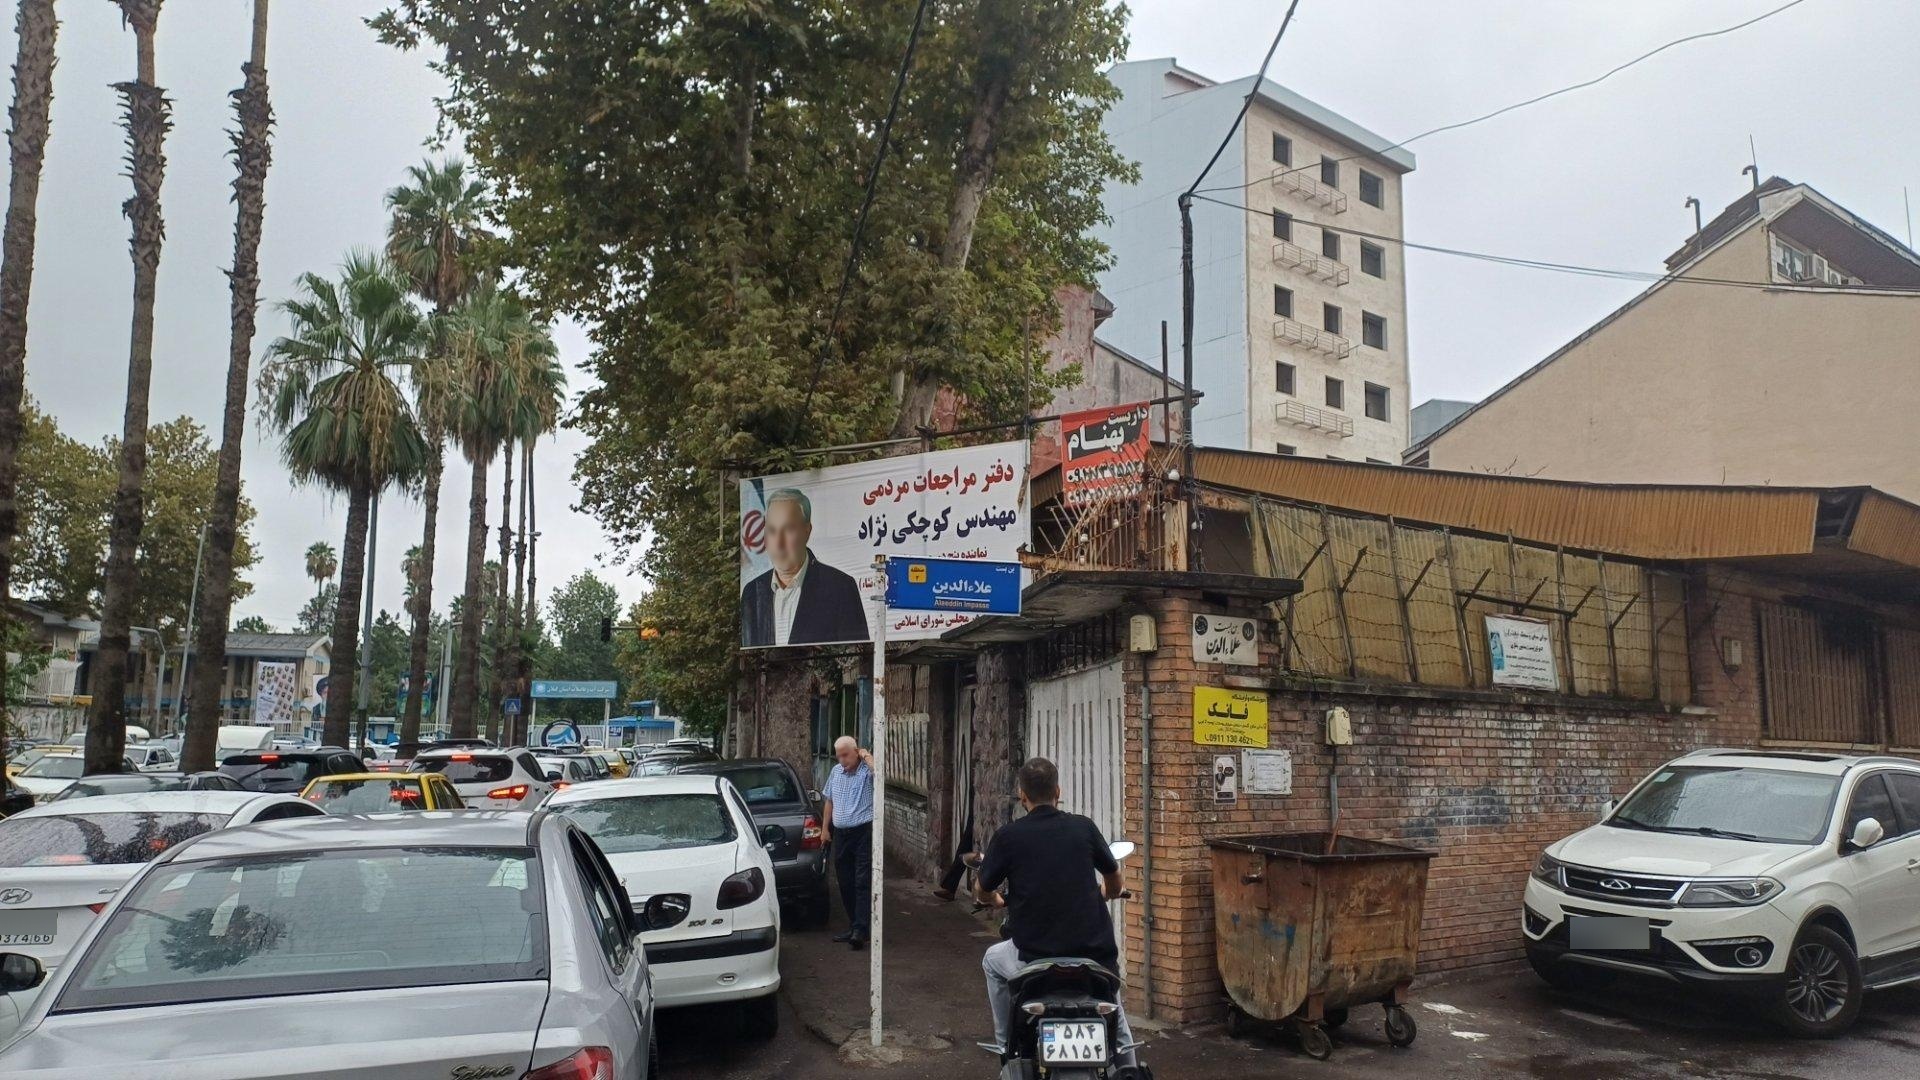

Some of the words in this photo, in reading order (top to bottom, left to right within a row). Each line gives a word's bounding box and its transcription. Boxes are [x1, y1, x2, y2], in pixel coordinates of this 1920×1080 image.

[1107, 404, 1148, 426] داربست
[1068, 424, 1125, 461] بهنام
[913, 465, 977, 495] مراجعات
[981, 459, 1014, 492] دفتر
[863, 479, 909, 505] مردمی
[858, 513, 887, 546] نژاد
[892, 506, 951, 543] کوچکی
[956, 505, 1016, 537] مهندس
[960, 547, 988, 558] نماینده
[932, 579, 992, 595] علاءالدین
[894, 614, 919, 630] اسلامی
[920, 614, 944, 629] شورای
[945, 613, 969, 627] مجلس
[1209, 733, 1224, 743] 0911
[1063, 1024, 1096, 1040] ۵۸۴
[1046, 1044, 1102, 1060] ۶۸۱۵۴
